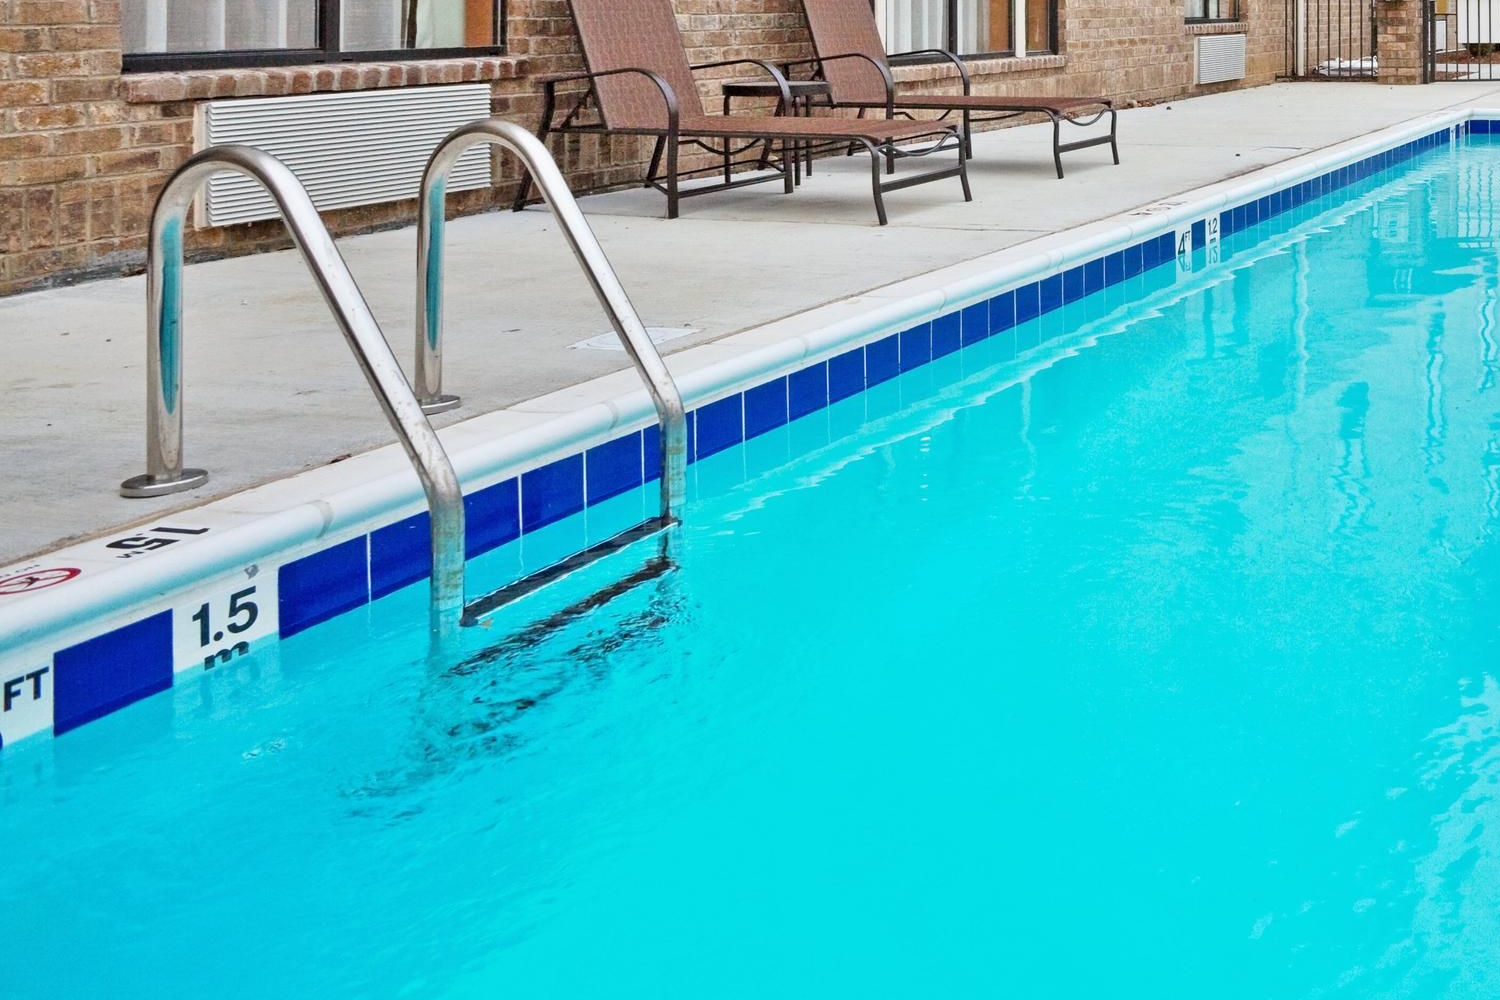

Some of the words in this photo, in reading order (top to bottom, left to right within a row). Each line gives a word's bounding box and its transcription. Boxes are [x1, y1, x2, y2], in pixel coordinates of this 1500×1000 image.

[1208, 217, 1218, 235] 1.2
[192, 586, 259, 648] 1.5
[4, 666, 50, 712] FT
